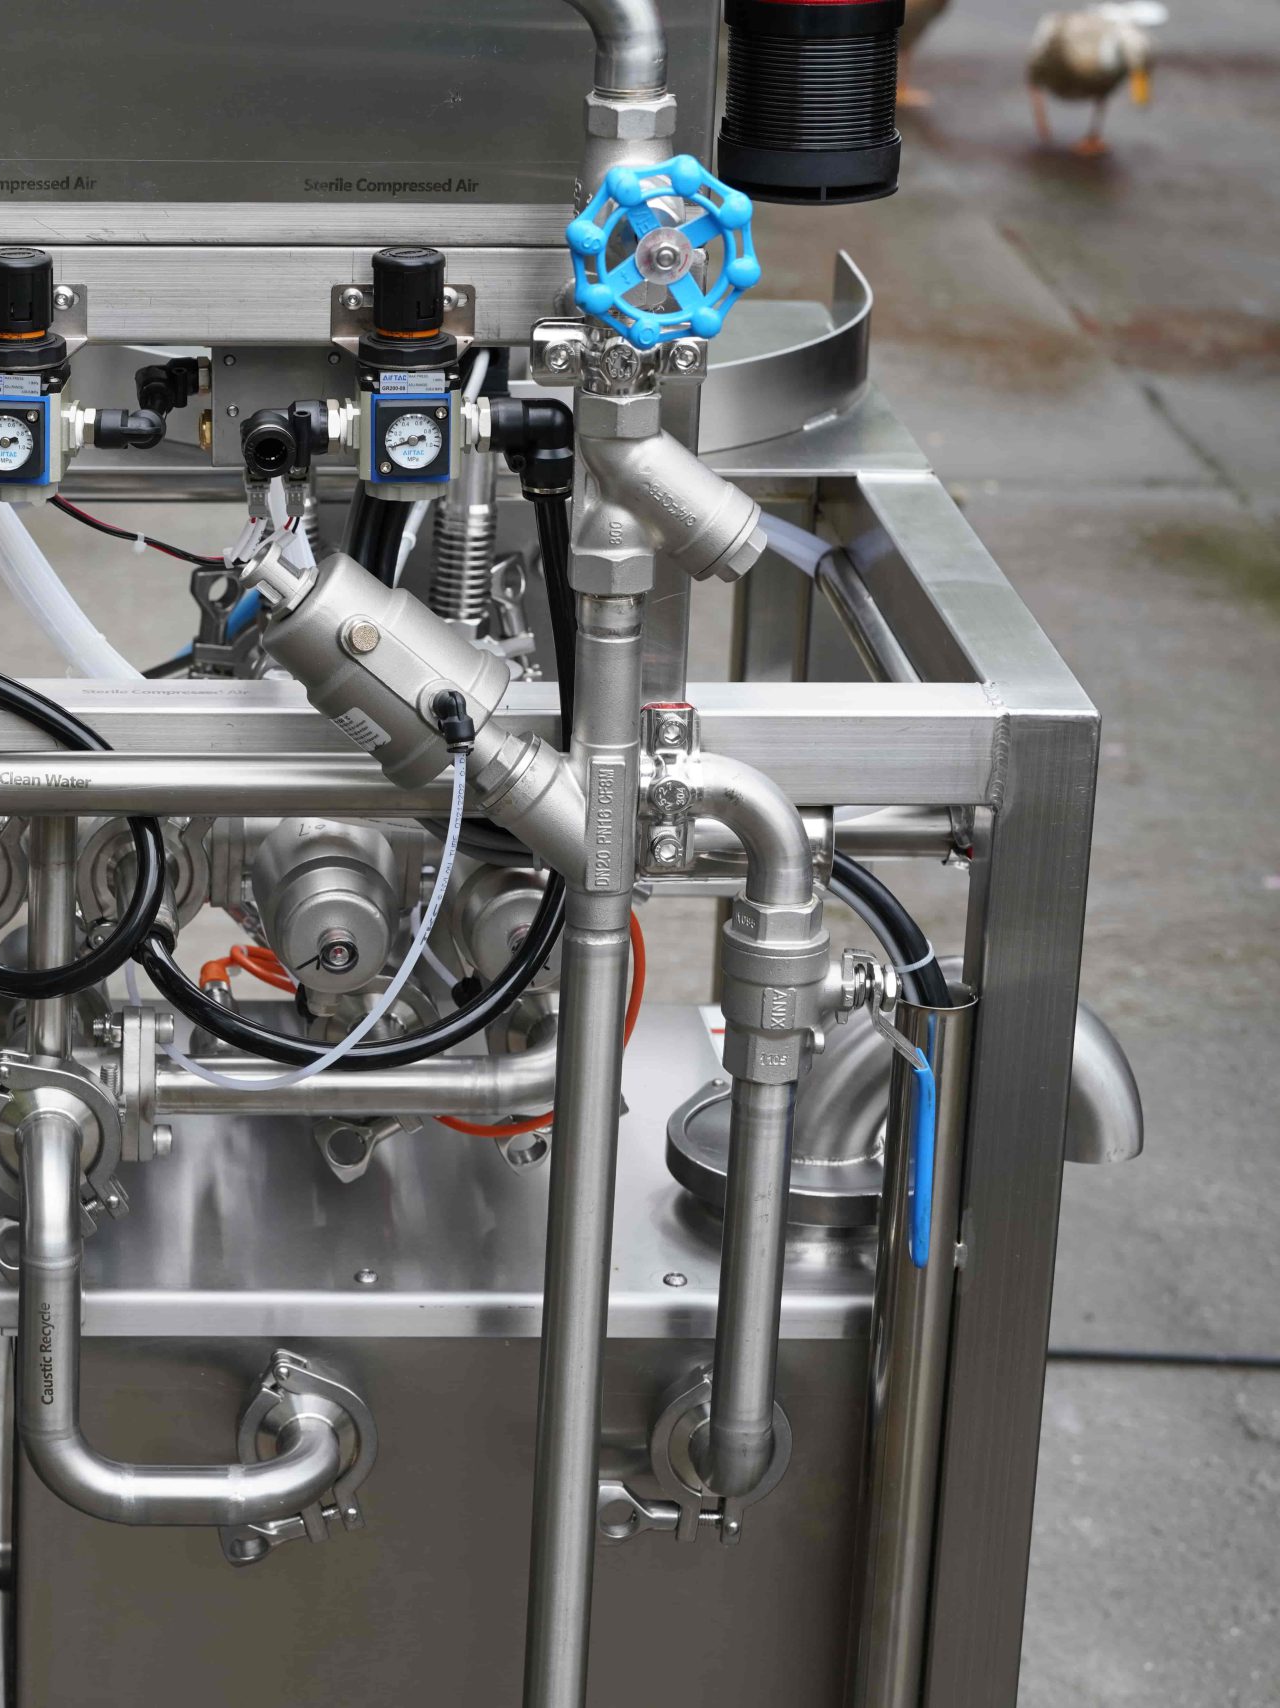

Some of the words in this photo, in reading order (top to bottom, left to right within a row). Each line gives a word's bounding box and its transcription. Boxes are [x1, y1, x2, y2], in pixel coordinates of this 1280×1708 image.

[73, 176, 98, 190] Air
[303, 177, 353, 193] Sterile
[355, 177, 452, 196] Compressed
[455, 178, 480, 193] Air
[44, 773, 92, 789] Water
[597, 768, 615, 804] CF8M
[675, 787, 686, 806] 304
[596, 808, 613, 845] PN16
[594, 850, 611, 887] DN20
[770, 989, 788, 1029] ANIX
[39, 1302, 56, 1353] Recycle
[40, 1356, 55, 1405] Caustic
